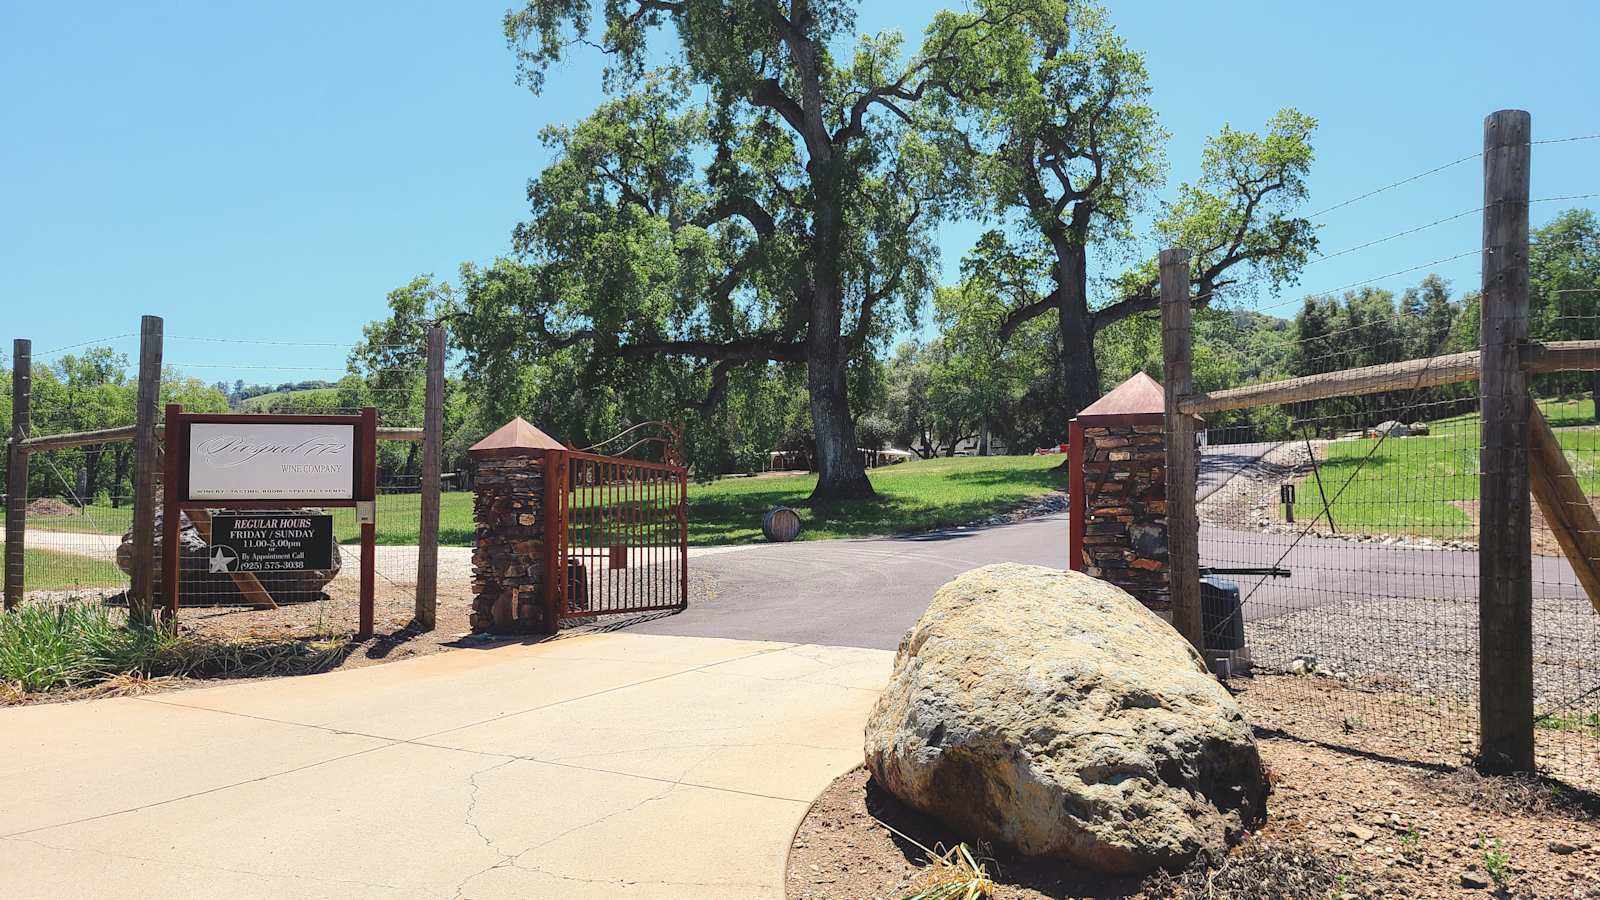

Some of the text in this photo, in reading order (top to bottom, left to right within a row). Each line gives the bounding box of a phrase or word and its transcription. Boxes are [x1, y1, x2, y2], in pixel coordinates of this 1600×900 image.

[281, 464, 342, 473] WINE COMPANY
[233, 518, 312, 529] REGULAR HOURS
[230, 530, 267, 539] FRIDAY
[274, 529, 316, 538] SUNDAY
[241, 551, 305, 561] By Appointment Call
[240, 561, 262, 571] (925)
